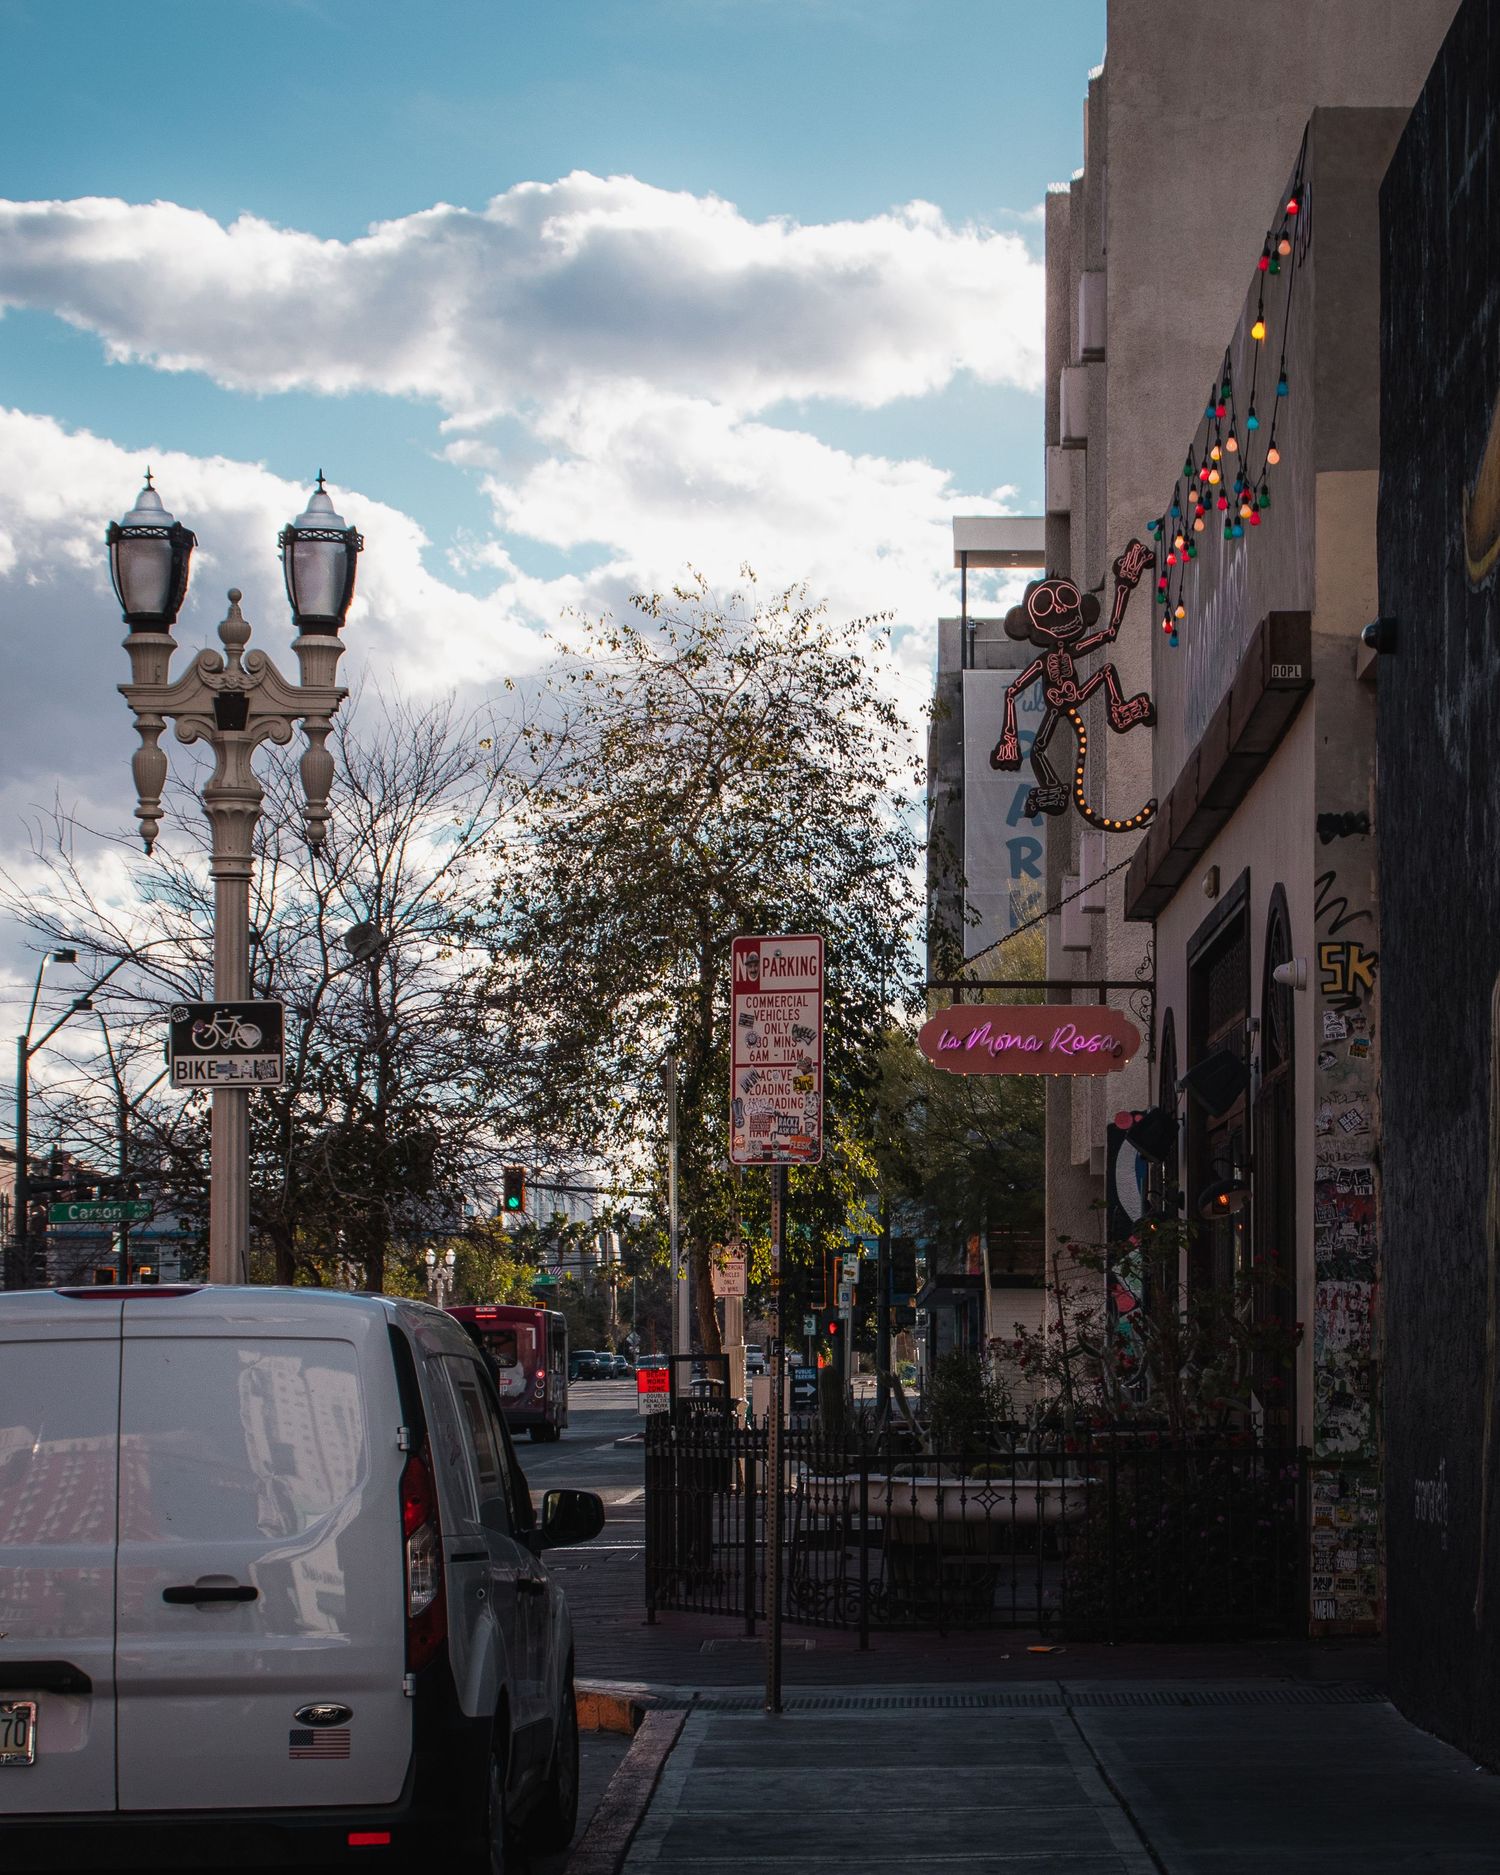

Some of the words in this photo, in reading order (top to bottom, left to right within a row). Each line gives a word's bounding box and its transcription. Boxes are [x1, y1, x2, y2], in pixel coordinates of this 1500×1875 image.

[762, 956, 817, 977] PARKING
[746, 995, 808, 1008] COMMERCIAL
[754, 1009, 800, 1021] VEHICLES
[764, 1023, 789, 1034] ONLY
[774, 1036, 797, 1048] MINS
[966, 1021, 1044, 1057] Mona
[1049, 1023, 1121, 1056] Rosa
[749, 1050, 769, 1062] 6AM
[783, 1049, 804, 1061] 11AM
[176, 1060, 219, 1080] BIKE
[760, 1069, 793, 1081] ACVE
[68, 1204, 123, 1220] Carson
[309, 1708, 339, 1721] Ford
